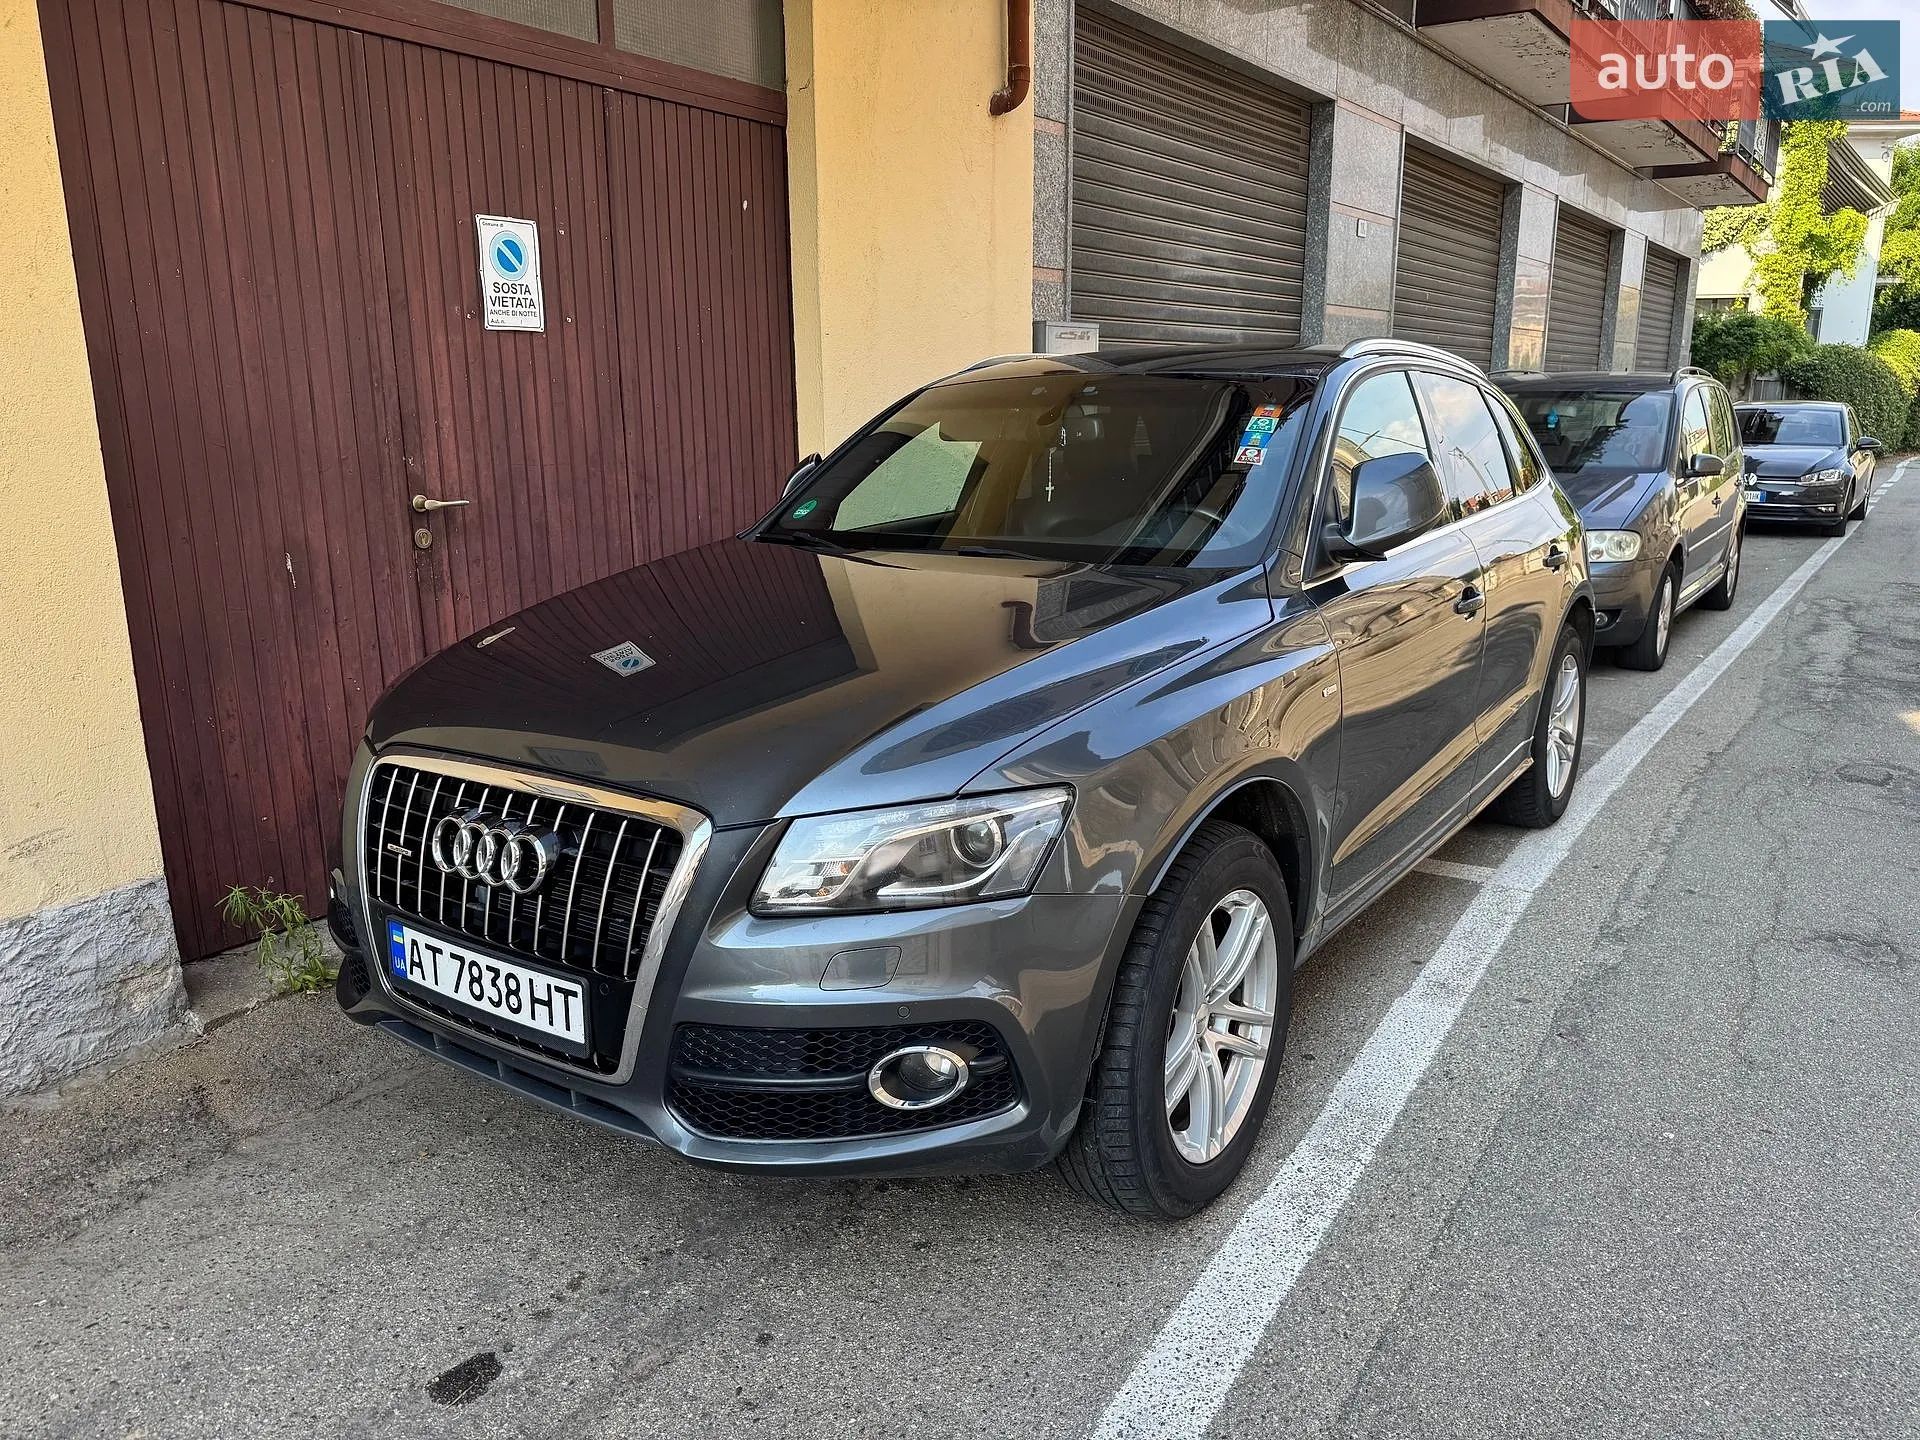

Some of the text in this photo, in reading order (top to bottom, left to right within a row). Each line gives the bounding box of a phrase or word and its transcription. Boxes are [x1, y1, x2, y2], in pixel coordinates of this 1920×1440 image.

[493, 282, 531, 295] SOSTA
[489, 296, 536, 310] VIETATA
[490, 309, 511, 317] ANCHE
[519, 310, 538, 318] NOTTE
[395, 957, 406, 971] UA
[409, 938, 579, 1032] AT 7838 HT
